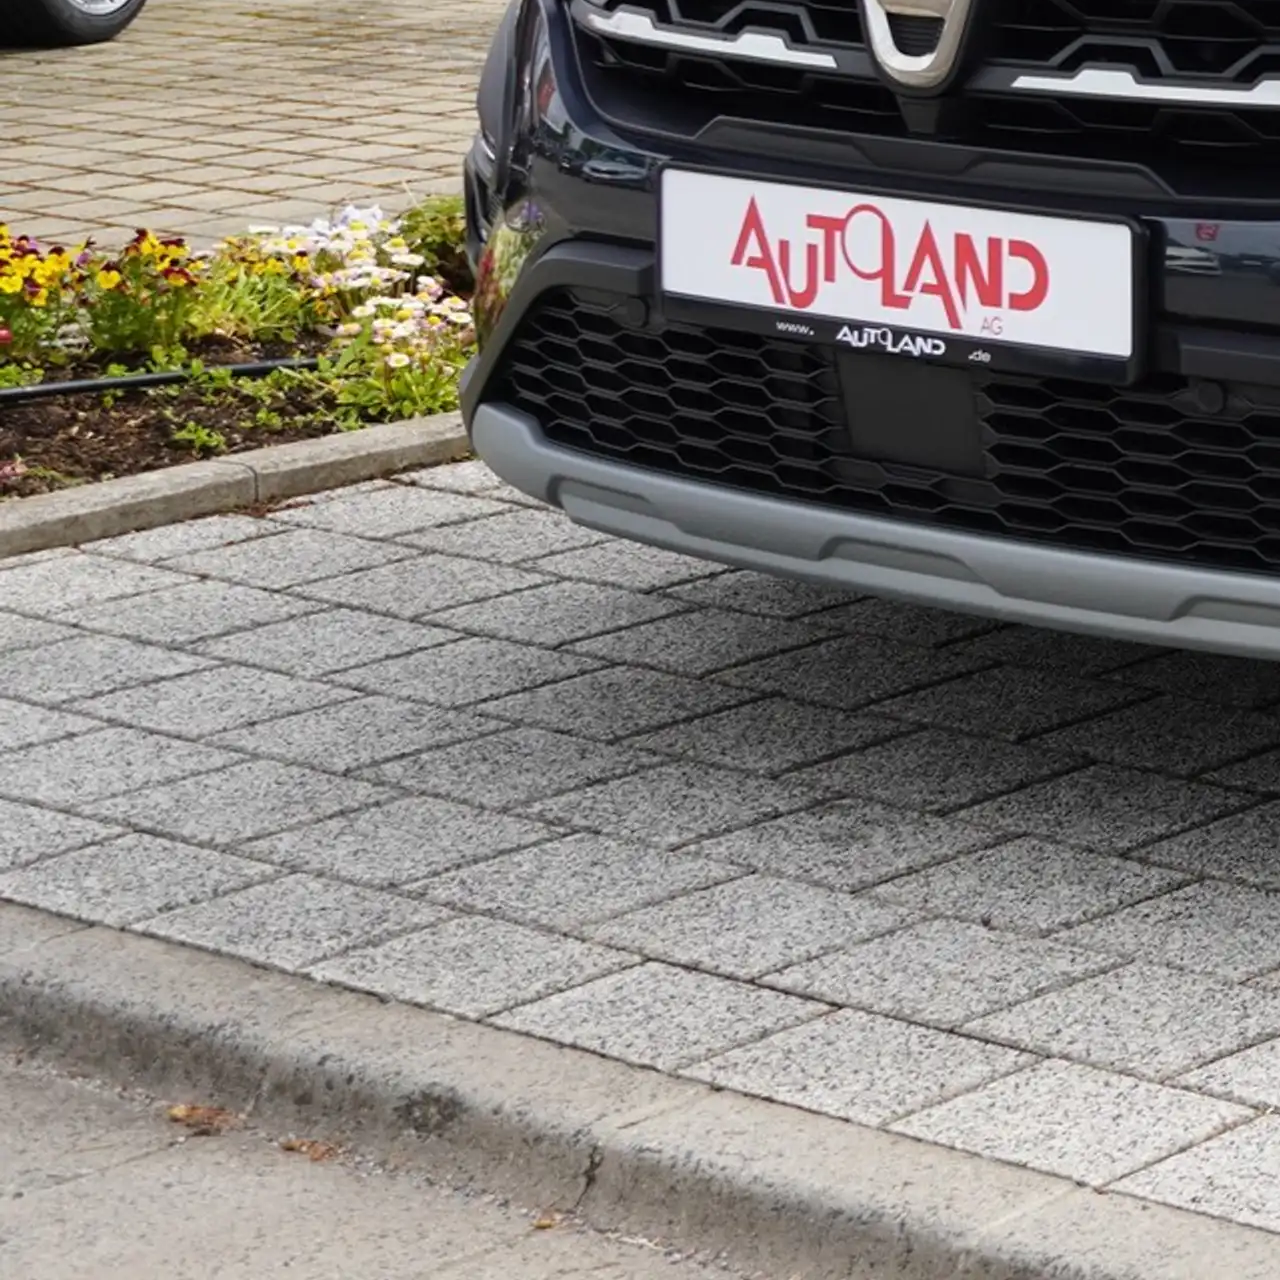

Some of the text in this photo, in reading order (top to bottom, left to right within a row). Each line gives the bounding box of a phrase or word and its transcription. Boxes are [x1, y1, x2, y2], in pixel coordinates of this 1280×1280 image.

[729, 192, 1052, 332] AUTOLAND
[775, 320, 993, 363] www. AUTOLAND .de
[979, 315, 1004, 336] AG
